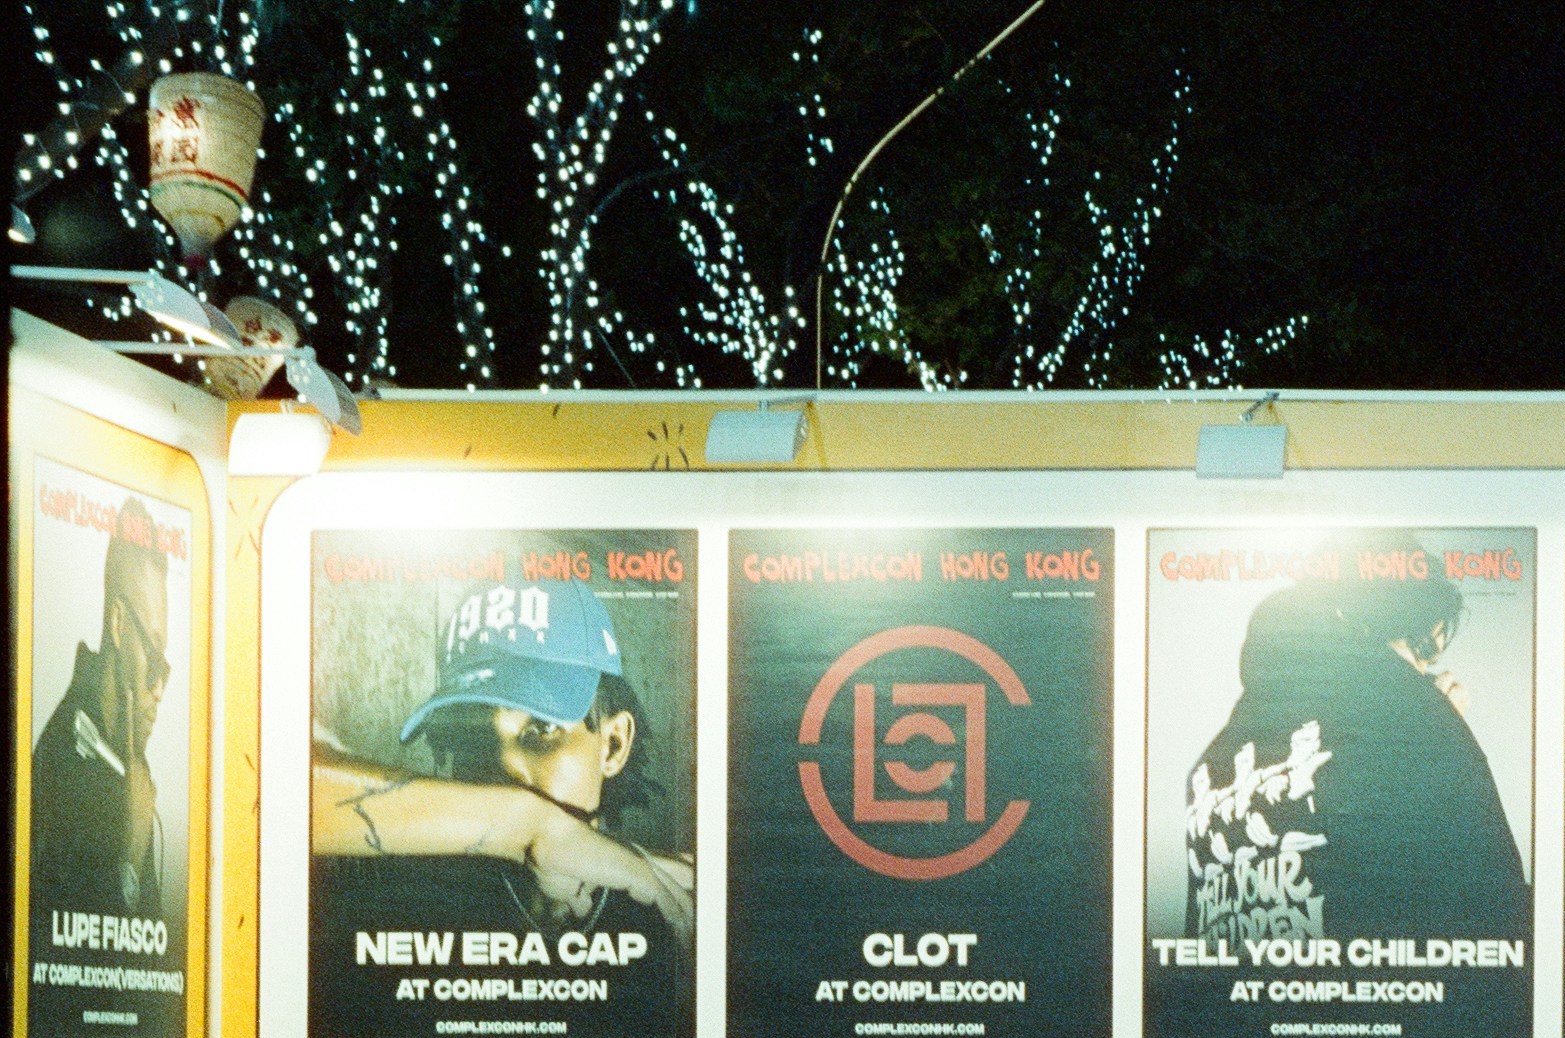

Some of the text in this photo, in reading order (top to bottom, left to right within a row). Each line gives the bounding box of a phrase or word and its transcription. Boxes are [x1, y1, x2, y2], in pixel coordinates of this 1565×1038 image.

[741, 547, 1104, 584] COMPLEXCON HONG KONG
[52, 910, 168, 956] LUPE FIASCO
[356, 931, 648, 966] NEW ERA CAP
[862, 932, 978, 967] CLOT
[1151, 937, 1525, 967] TELL YOUR CHILDREN
[33, 962, 48, 984] AT
[395, 978, 608, 1001] AT COMPLEXCON
[815, 980, 1026, 1002] AT COMPLEXCON
[1229, 980, 1444, 1003] AT COMPLEXCON
[435, 1020, 567, 1034] COMPLEXCONHK.COM
[854, 1022, 985, 1036] COMPLEXCONHK.COM
[1270, 1023, 1402, 1036] COMPLEXCONHK.COM
